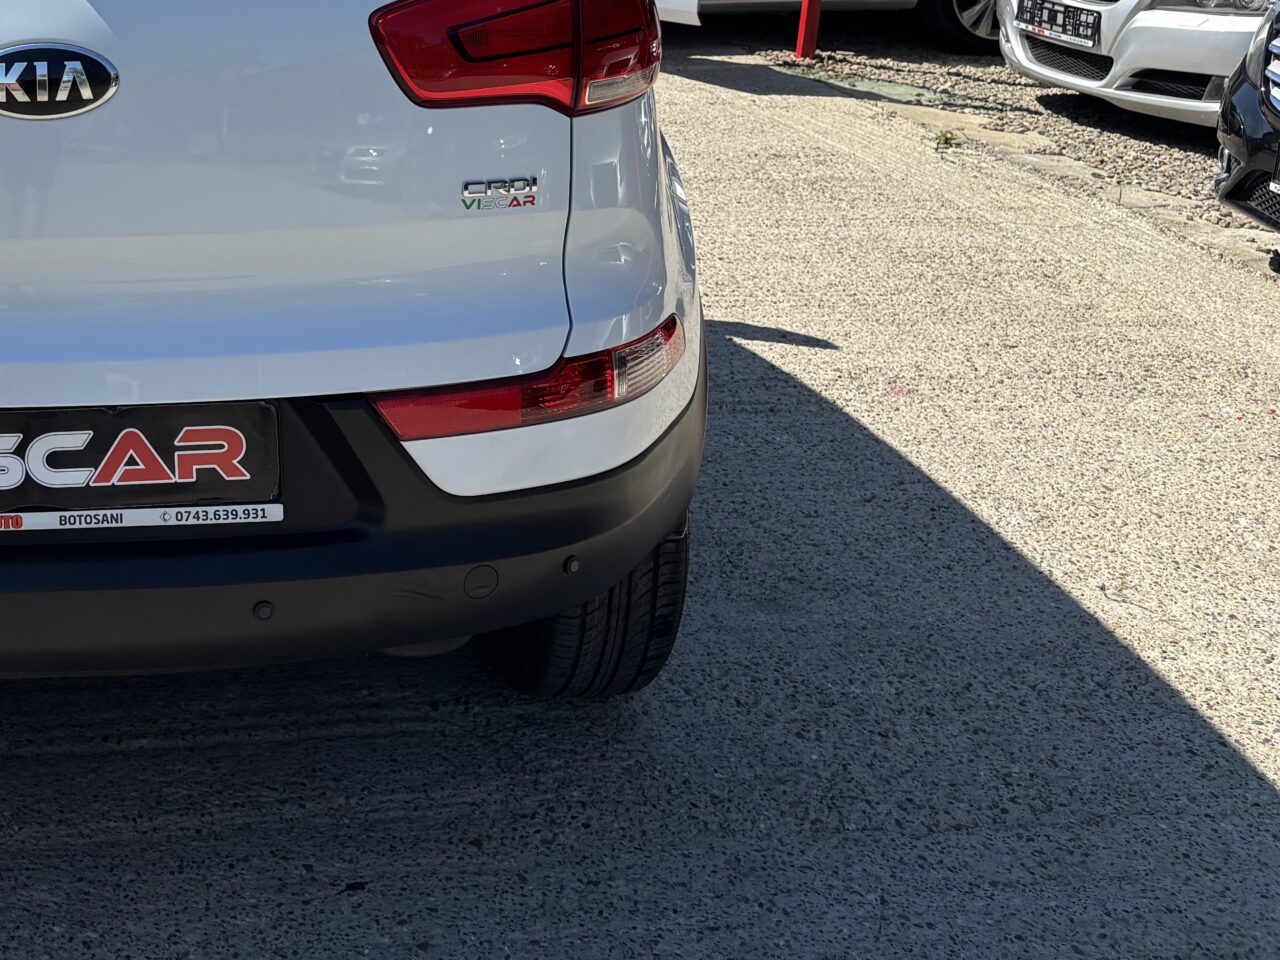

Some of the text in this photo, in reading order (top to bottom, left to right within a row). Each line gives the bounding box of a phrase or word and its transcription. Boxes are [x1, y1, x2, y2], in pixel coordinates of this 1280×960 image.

[460, 194, 536, 210] VISCAR
[58, 512, 124, 526] BOTOSANI
[175, 507, 268, 522] 0743.639.931
